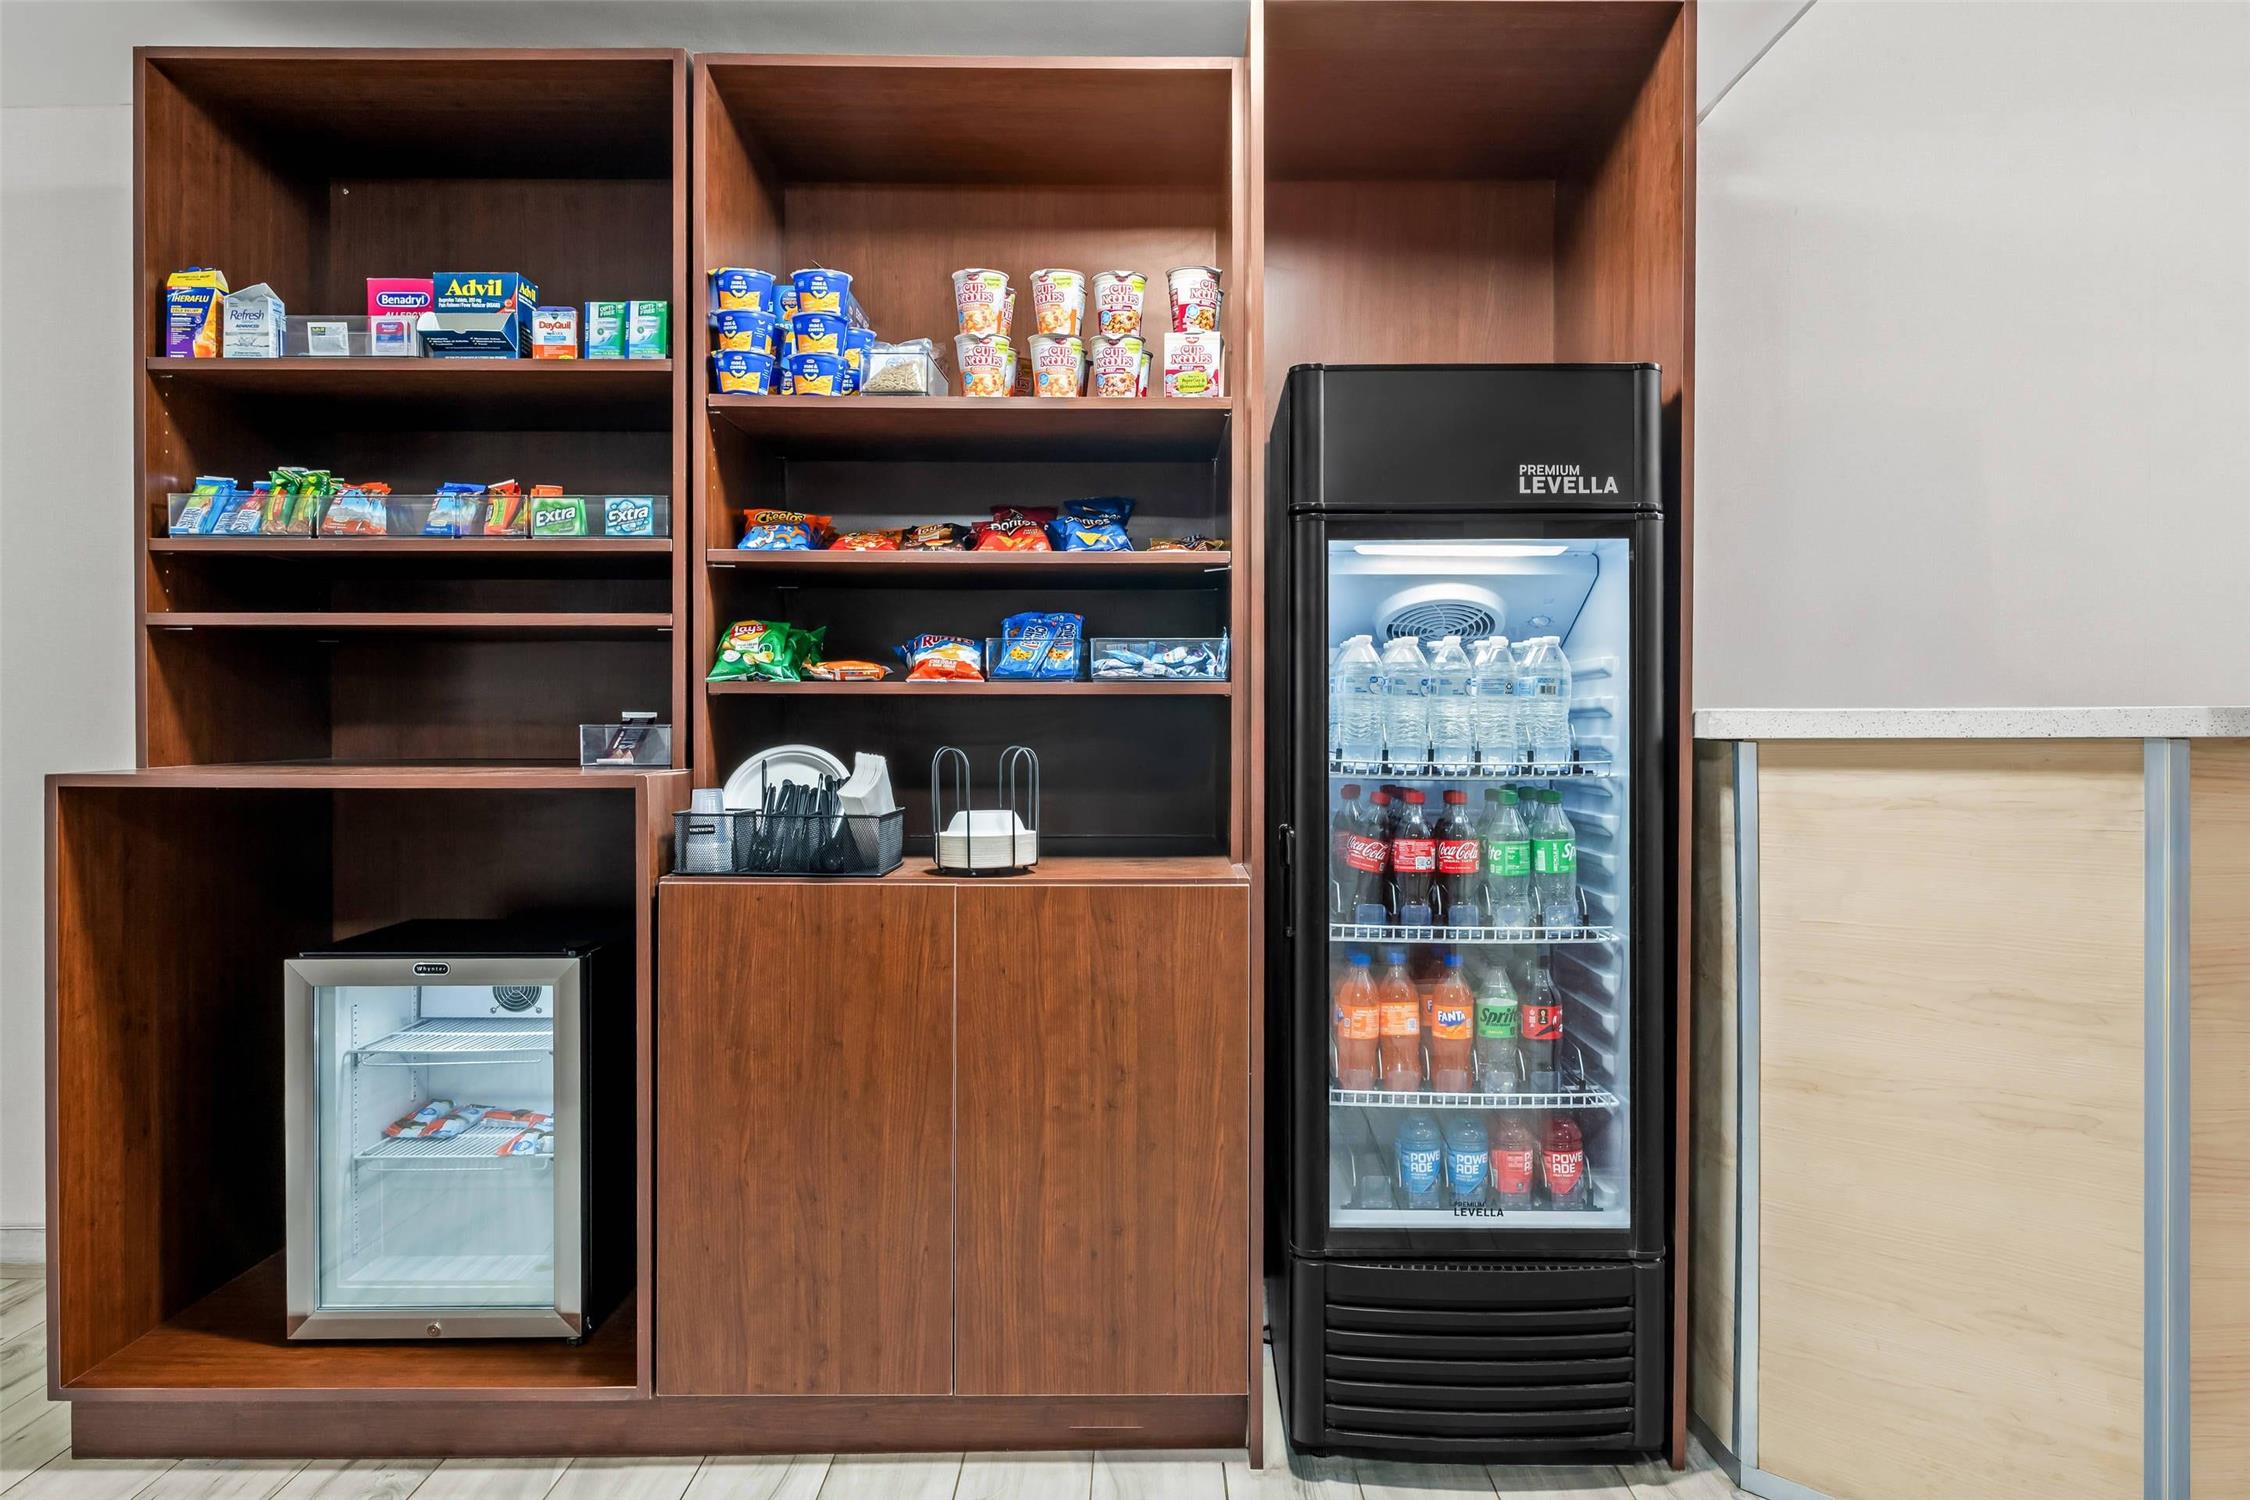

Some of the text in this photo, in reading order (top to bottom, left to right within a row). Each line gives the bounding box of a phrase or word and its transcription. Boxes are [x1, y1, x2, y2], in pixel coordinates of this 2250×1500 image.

[445, 278, 502, 296] Advil
[519, 281, 536, 303] Advil
[963, 283, 986, 294] CUP
[1109, 283, 1133, 295] CUP
[170, 291, 210, 303] THERAFLU
[381, 294, 425, 308] Benadryl
[1101, 293, 1139, 306] NOODLES
[230, 309, 265, 321] Refresh
[539, 321, 571, 331] DayQuil
[973, 346, 997, 357] CUP
[1048, 346, 1072, 357] CUP
[1103, 346, 1127, 358] CUP
[1181, 345, 1205, 355] CUP
[964, 355, 1003, 367] NOODLES
[1040, 355, 1077, 367] NOODLES
[1097, 355, 1133, 368] NOODLES
[1171, 353, 1212, 365] NOODLES
[1519, 464, 1580, 476] PREMIUM
[1519, 476, 1619, 494] LEVELLA
[536, 506, 576, 527] Extra
[607, 506, 649, 526] Extra
[755, 511, 806, 524] Cheetos
[990, 518, 1038, 531] Doritos
[734, 624, 764, 635] Lay's
[1347, 835, 1388, 860] Coca-Cola
[1439, 841, 1479, 861] Coca-Cola
[1438, 1009, 1466, 1022] FANTA
[1410, 1162, 1433, 1173] ADE
[1456, 1164, 1479, 1175] ADE
[1552, 1163, 1576, 1174] ADE
[1454, 1200, 1486, 1208] PREMIUM
[1454, 1207, 1504, 1217] LEVELLA
